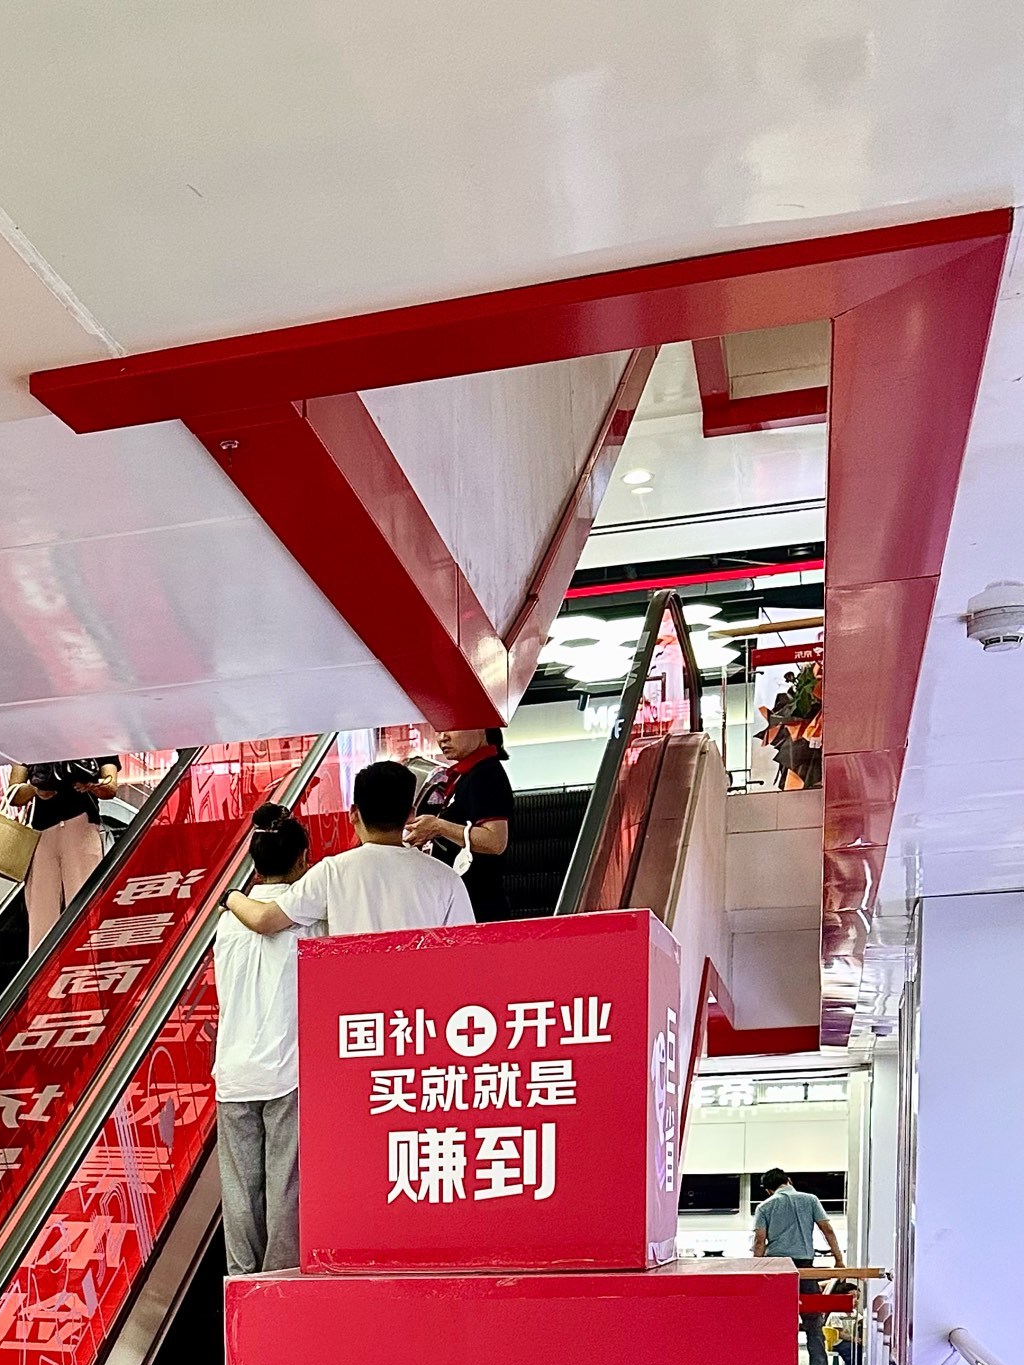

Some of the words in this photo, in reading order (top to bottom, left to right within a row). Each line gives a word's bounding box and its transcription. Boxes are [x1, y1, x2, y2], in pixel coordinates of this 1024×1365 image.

[369, 1059, 577, 1115] 买就就是
[387, 1122, 556, 1205] 赚到
